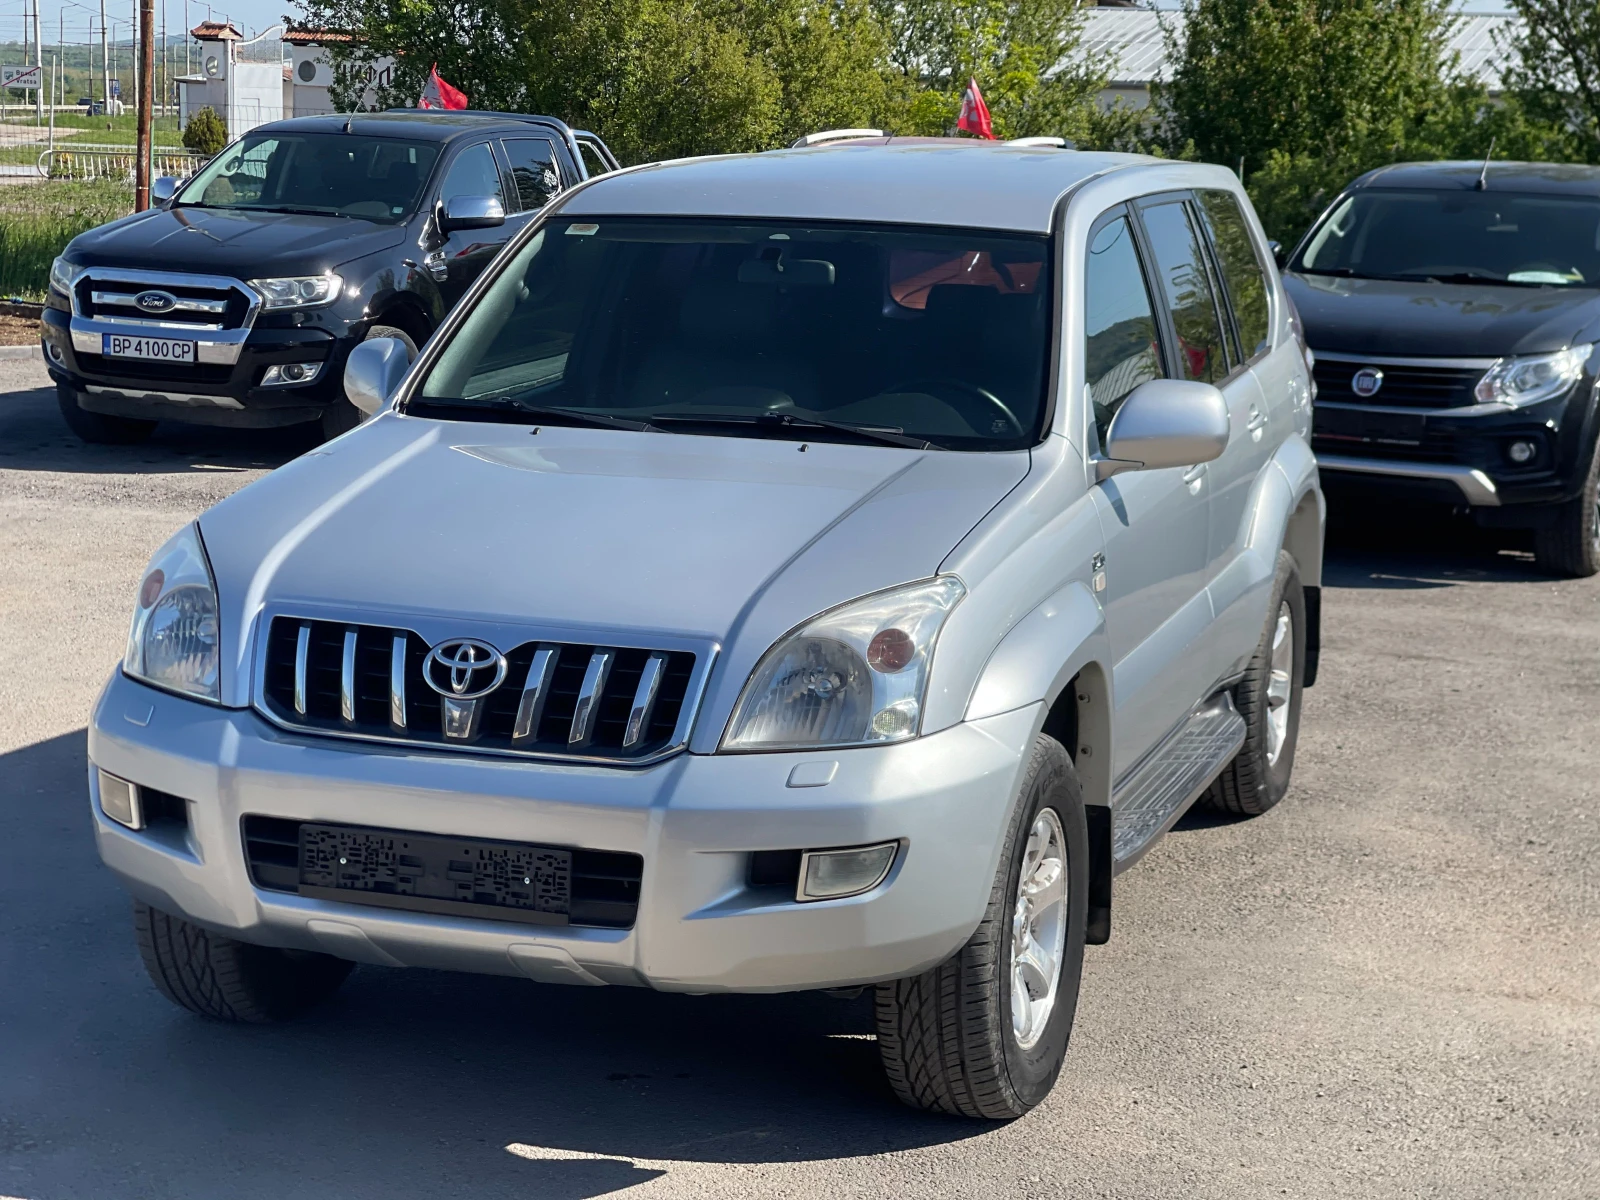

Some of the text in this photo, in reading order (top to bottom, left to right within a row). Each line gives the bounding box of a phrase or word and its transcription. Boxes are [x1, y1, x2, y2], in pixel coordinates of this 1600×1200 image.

[142, 295, 165, 307] Ford
[113, 338, 191, 359] BP 4100 CP
